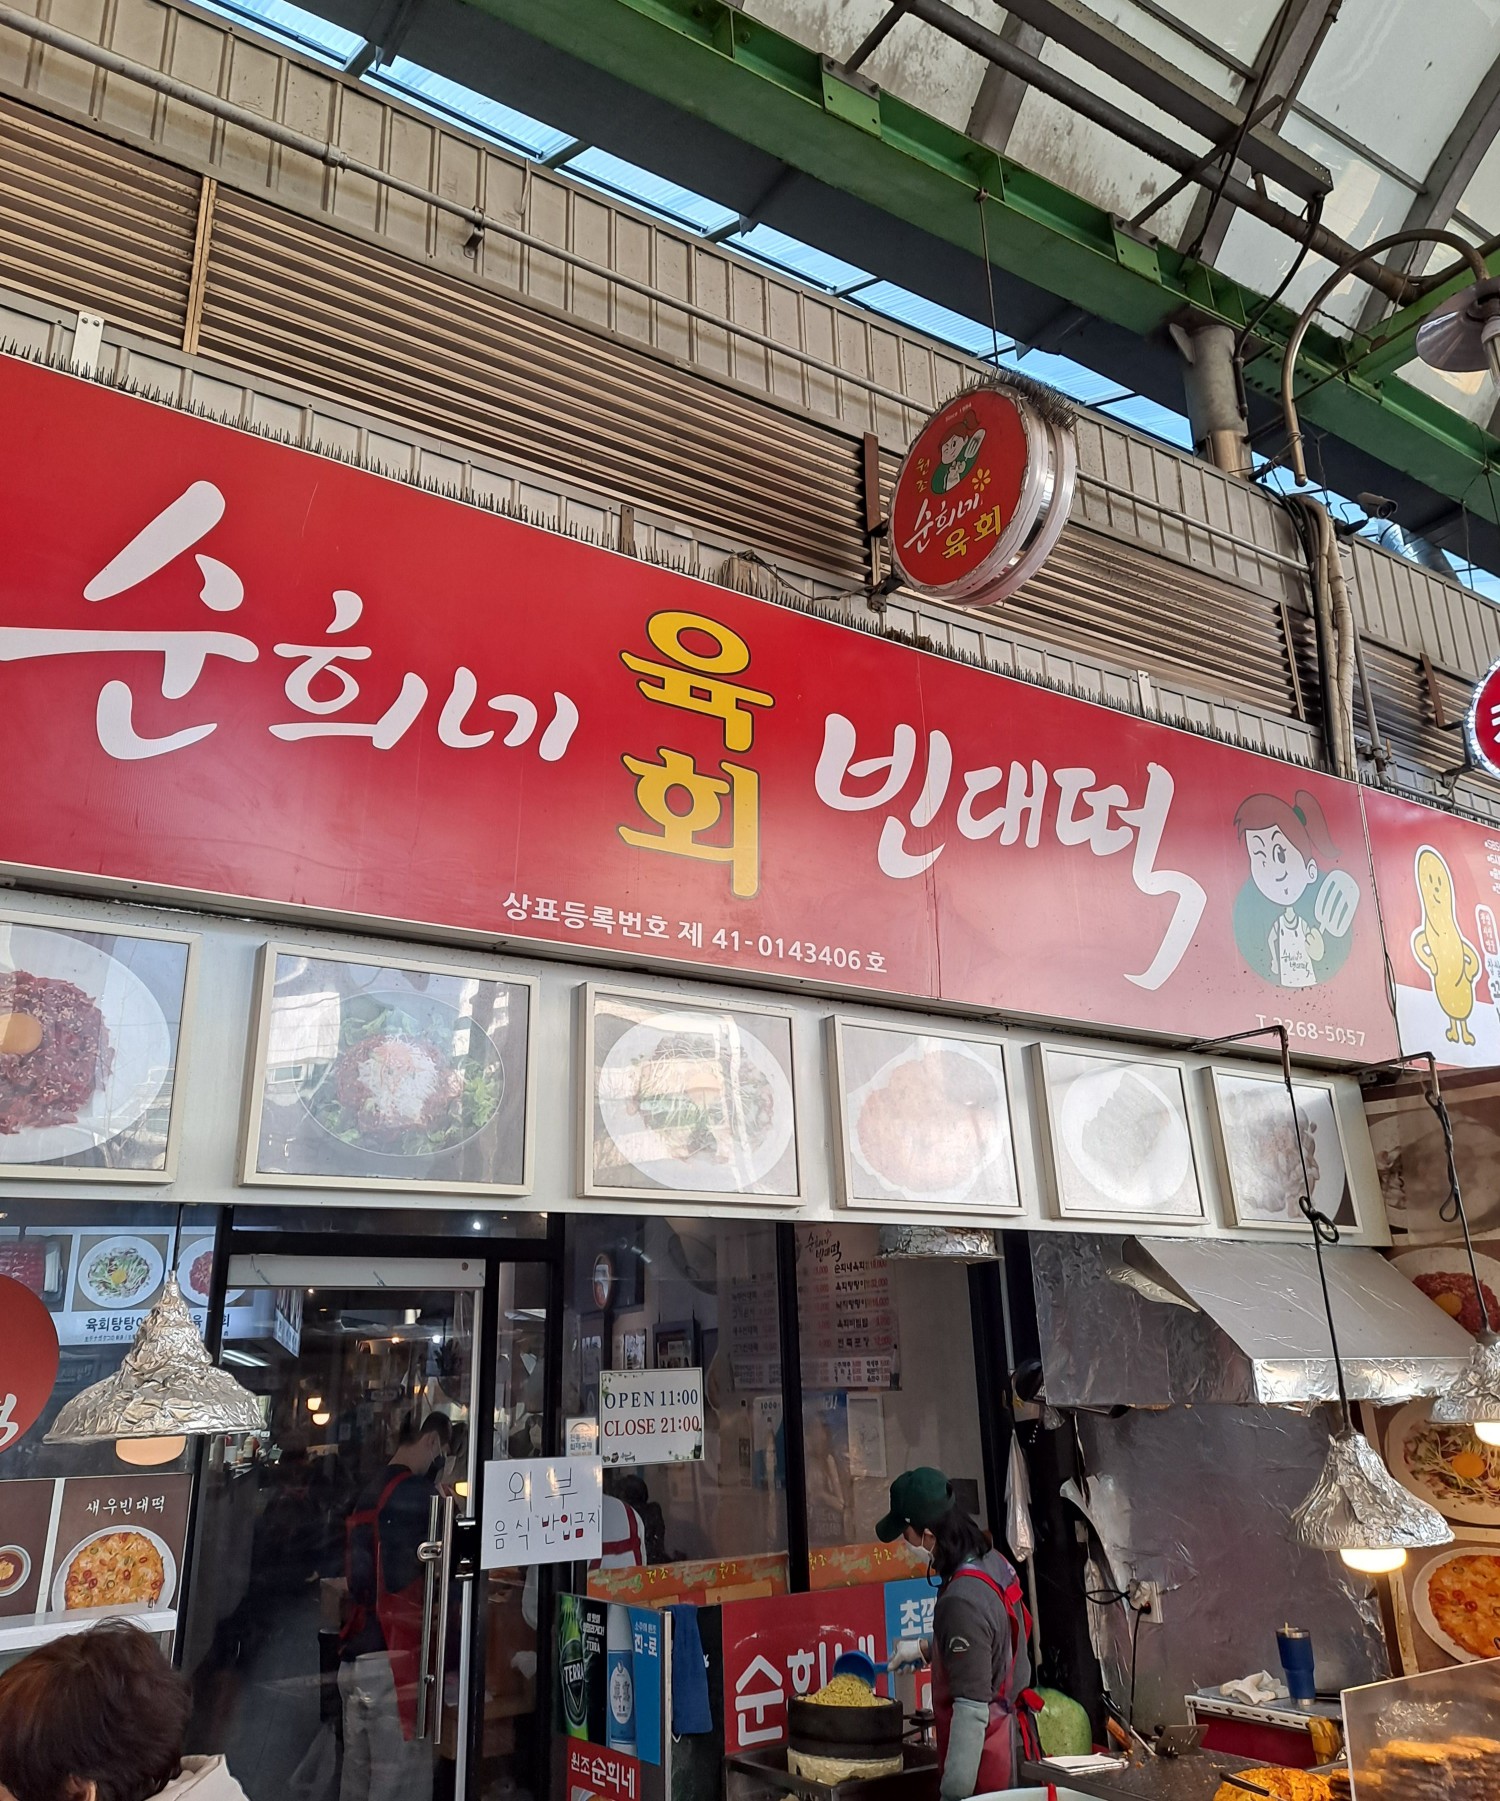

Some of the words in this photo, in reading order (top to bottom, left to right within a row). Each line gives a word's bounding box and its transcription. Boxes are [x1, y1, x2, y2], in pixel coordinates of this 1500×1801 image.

[903, 493, 980, 553] 순희네
[941, 505, 1001, 559] 육회
[0, 480, 579, 762] 순희네
[616, 609, 776, 899] 육회
[814, 713, 1207, 990] 빈대떡
[502, 891, 670, 940] 상표등록번호
[677, 921, 704, 949] 제
[604, 1391, 655, 1409] OPEN
[660, 1389, 699, 1406] 11:00
[604, 1418, 656, 1437] CLOSE
[660, 1416, 700, 1433] 21:00
[494, 1518, 530, 1551] 음식
[564, 1662, 585, 1685] TERRA
[571, 1751, 591, 1776] 원조
[591, 1757, 635, 1799] 순희네
